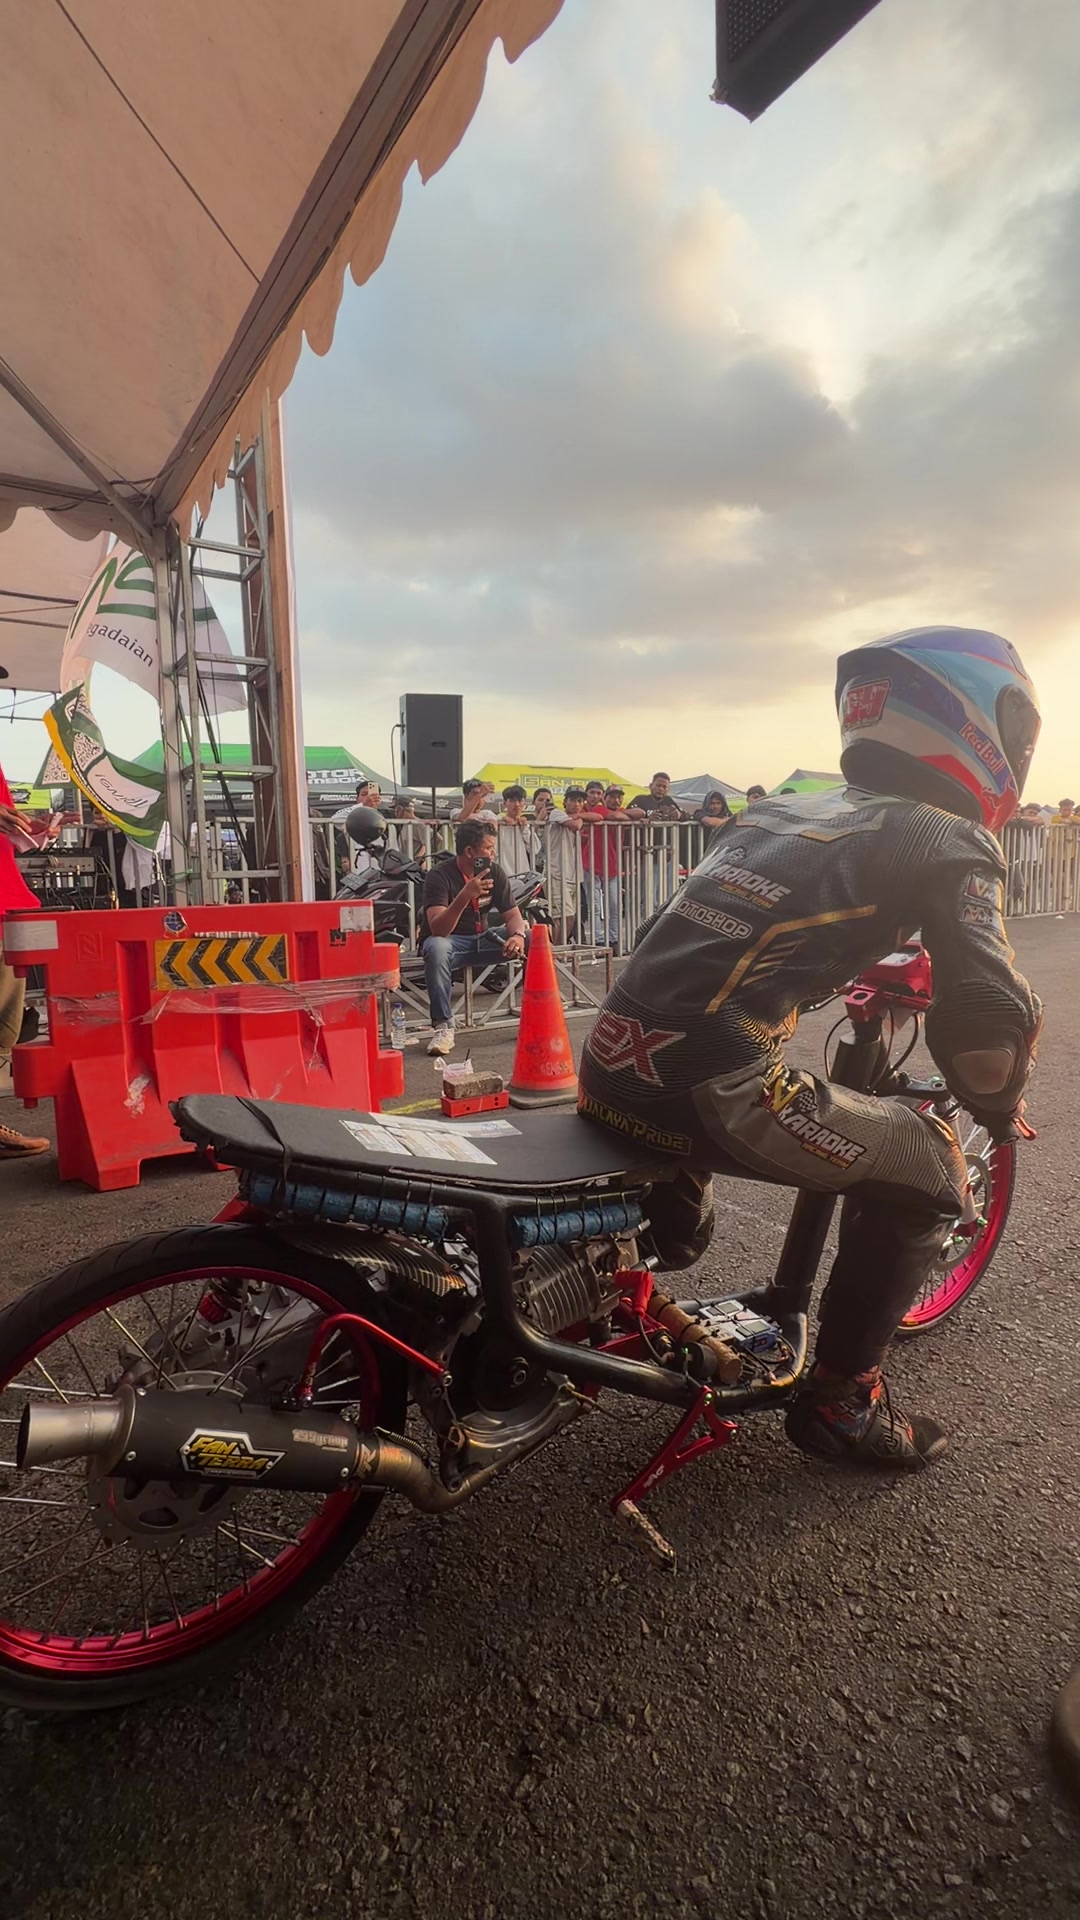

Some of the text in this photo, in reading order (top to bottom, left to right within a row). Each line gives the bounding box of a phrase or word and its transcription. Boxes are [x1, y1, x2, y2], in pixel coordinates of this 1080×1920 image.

[88, 623, 153, 667] gadaian
[708, 863, 792, 903] ARAOKE
[676, 899, 750, 938] OTOSHOP
[778, 1103, 866, 1162] KARAOKE
[189, 1437, 238, 1455] FAN
[198, 1452, 270, 1471] TERRA
